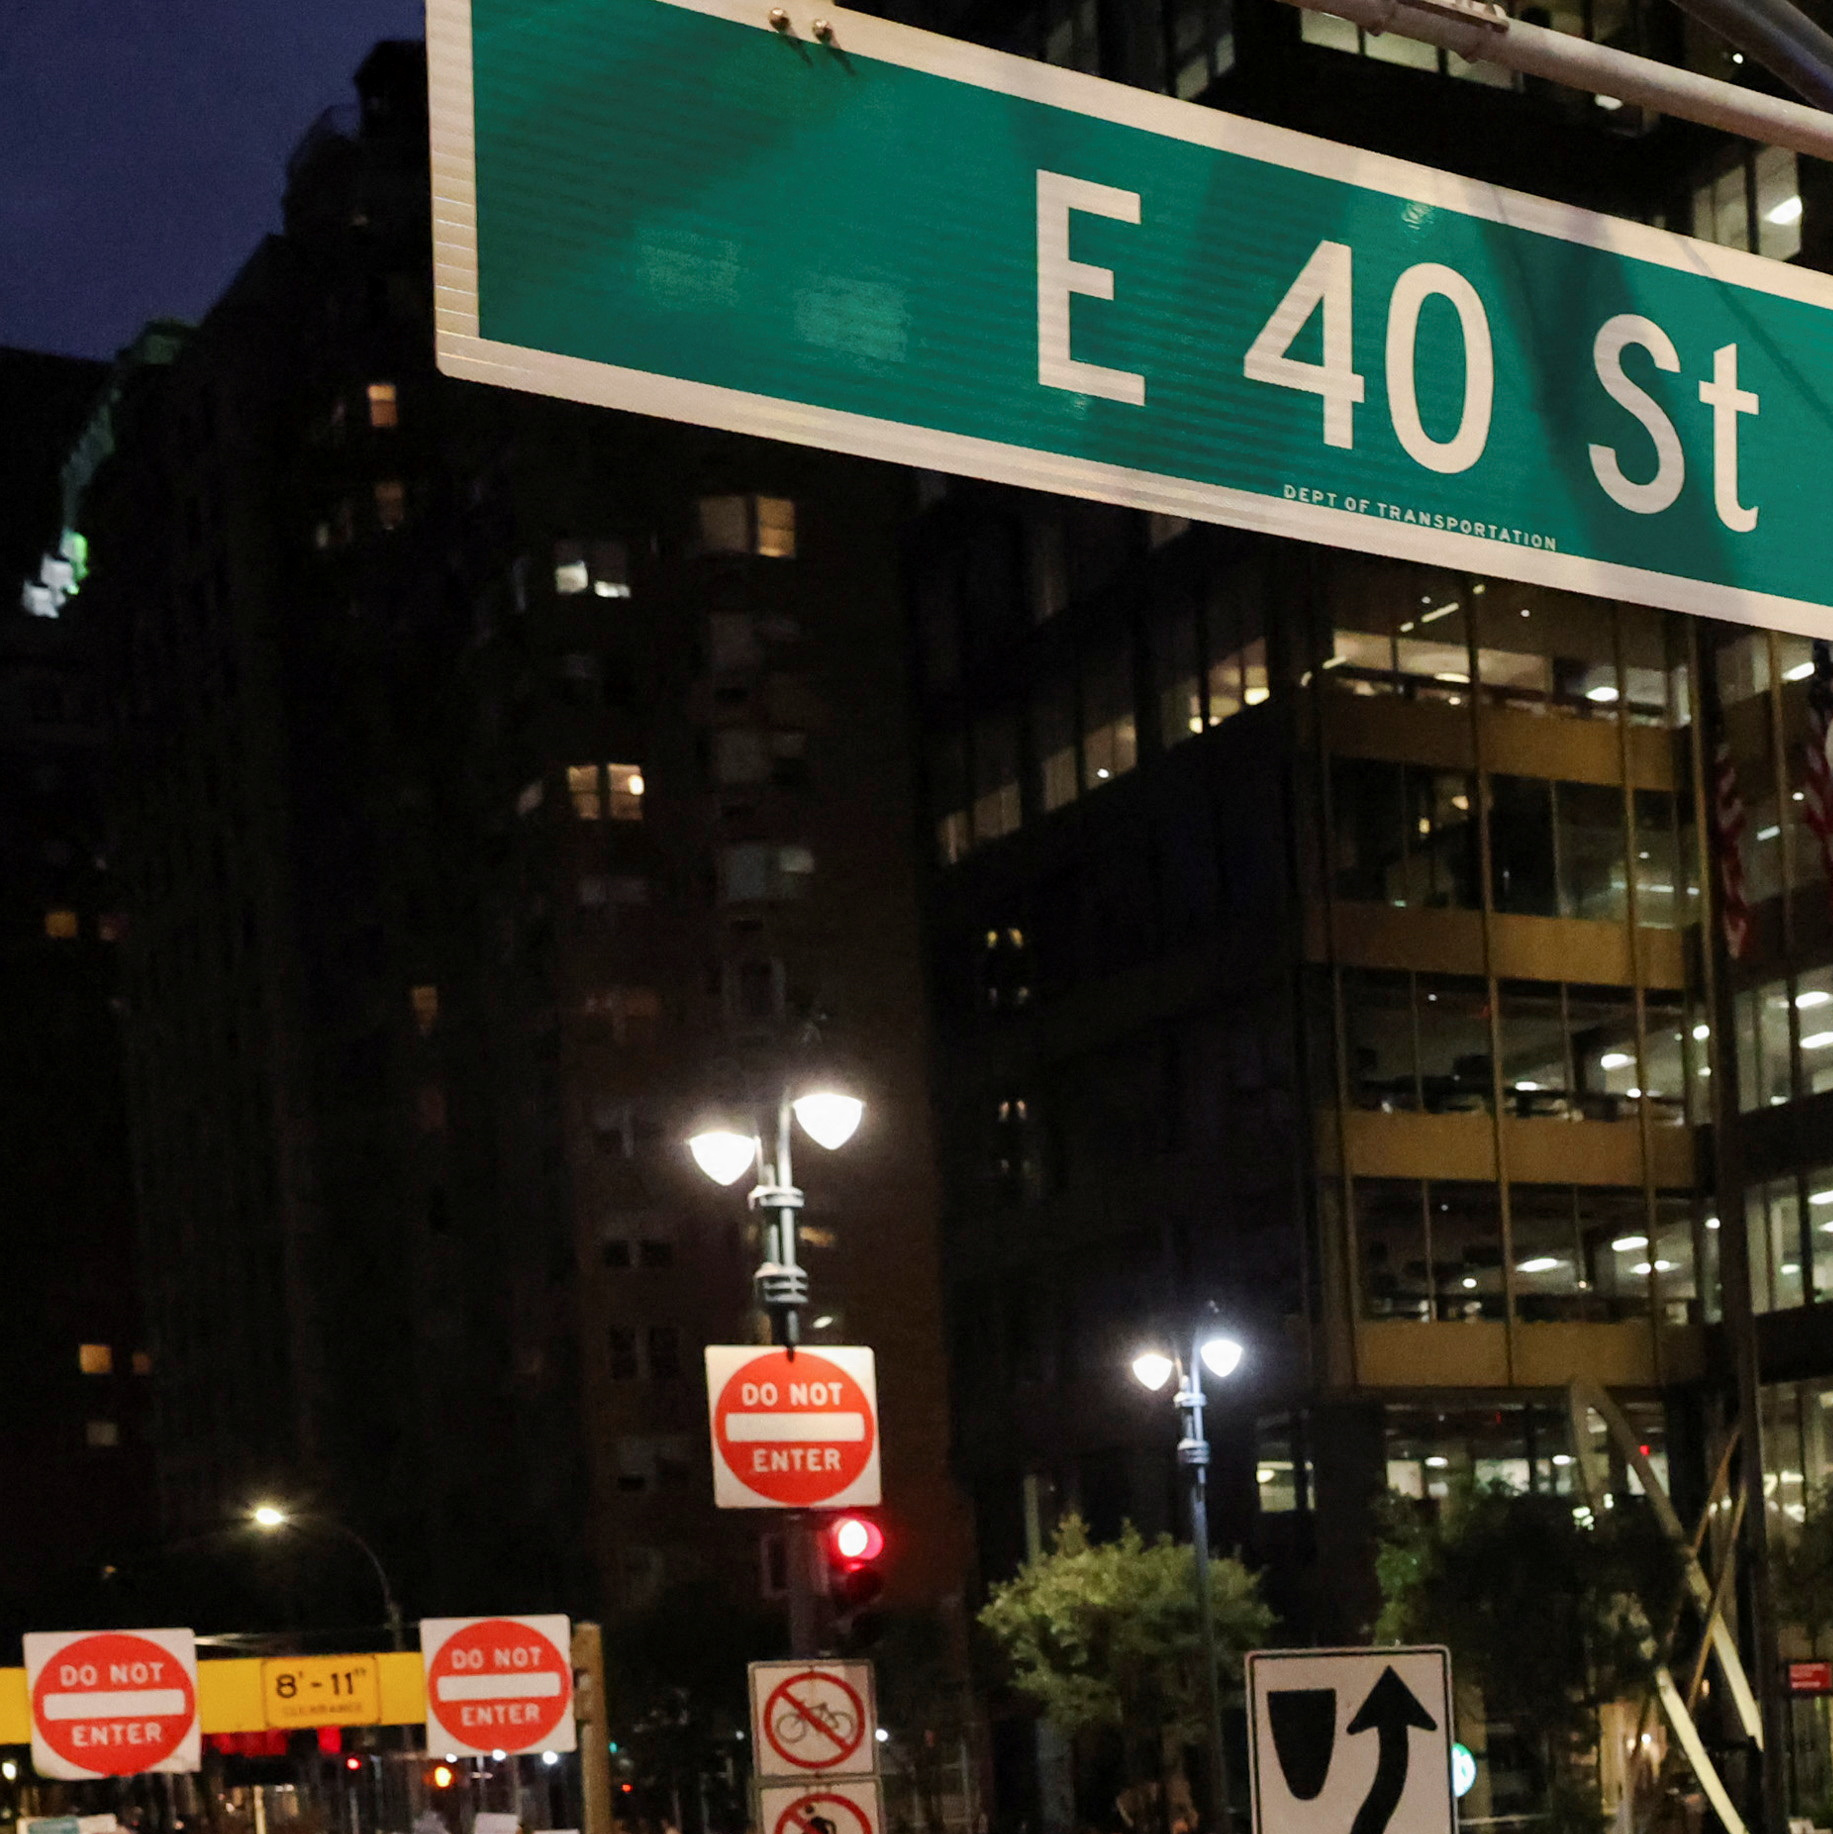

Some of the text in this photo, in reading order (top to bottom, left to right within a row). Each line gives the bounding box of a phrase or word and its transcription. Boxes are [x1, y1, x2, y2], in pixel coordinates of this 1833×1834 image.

[1035, 168, 1760, 535] E 40 St
[1283, 484, 1557, 552] DEPT OF TRANSPORTATION
[741, 1382, 843, 1406] DO NOT
[752, 1448, 842, 1472] ENTER
[451, 1647, 543, 1669] DO NOT
[60, 1662, 164, 1687] DO NOT
[461, 1702, 542, 1727] ENTER
[71, 1723, 163, 1748] ENTER
